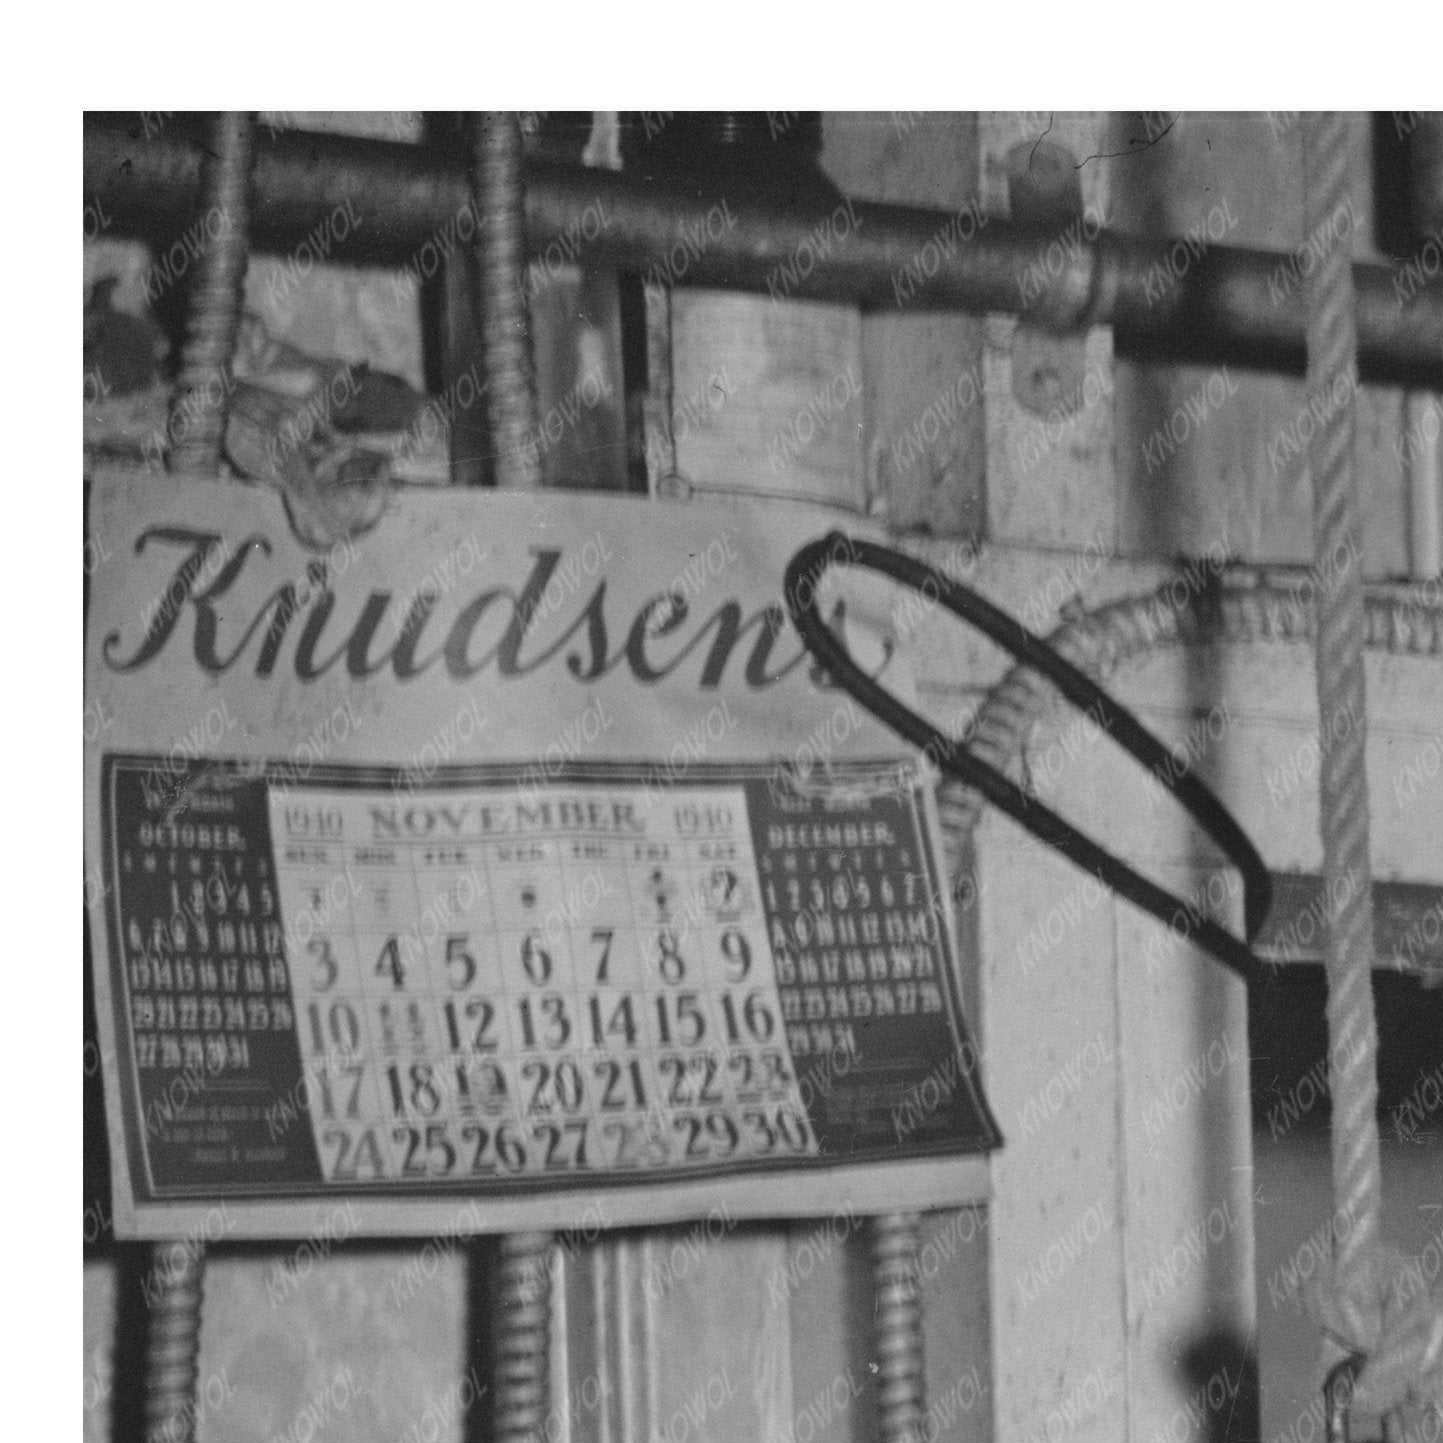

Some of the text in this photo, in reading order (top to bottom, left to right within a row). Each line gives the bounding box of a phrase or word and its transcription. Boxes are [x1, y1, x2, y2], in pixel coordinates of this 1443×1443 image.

[367, 799, 646, 838] NOVEMBER
[768, 821, 897, 849] DECEMBER
[306, 926, 753, 993] 3 4 5 6 7 8 9
[307, 988, 775, 1058] 10 11 12 13 14 15 16
[312, 1061, 365, 1121] 17
[386, 1061, 441, 1119] 18
[455, 1061, 508, 1118] 19
[521, 1057, 584, 1114] 20
[593, 1057, 648, 1112] 21
[657, 1053, 723, 1108] 22
[727, 1051, 791, 1104] 23
[321, 1127, 388, 1183] 24
[391, 1120, 457, 1178] 25
[461, 1122, 527, 1176] 26
[531, 1117, 590, 1170] 27
[603, 1118, 669, 1170] 28
[672, 1110, 740, 1159] 29
[741, 1106, 812, 1158] 30
